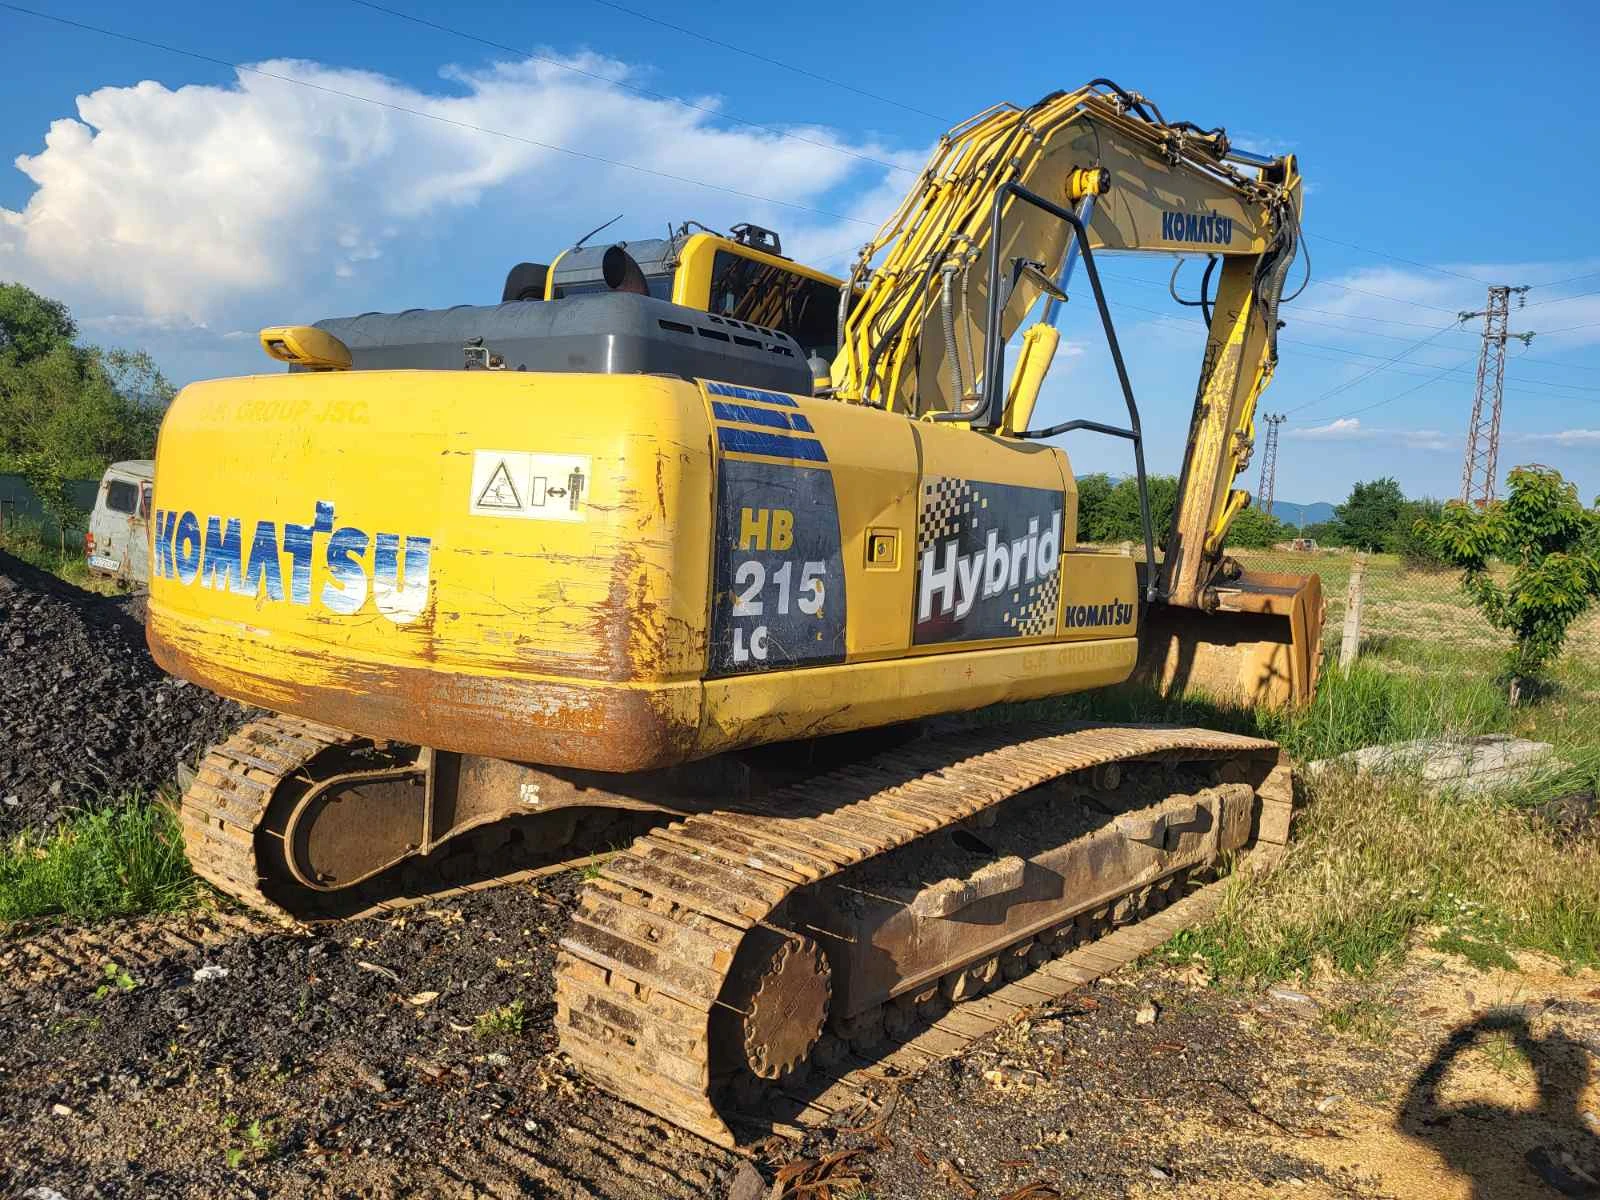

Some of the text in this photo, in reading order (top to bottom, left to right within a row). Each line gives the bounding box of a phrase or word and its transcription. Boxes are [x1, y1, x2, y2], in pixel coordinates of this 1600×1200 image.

[1162, 210, 1232, 244] KOMATSU
[739, 507, 794, 550] HB
[153, 500, 431, 624] KOMATSU
[918, 509, 1061, 624] Hybrid
[733, 559, 826, 617] 215
[1065, 597, 1133, 628] KOMATSU
[733, 626, 768, 662] LC
